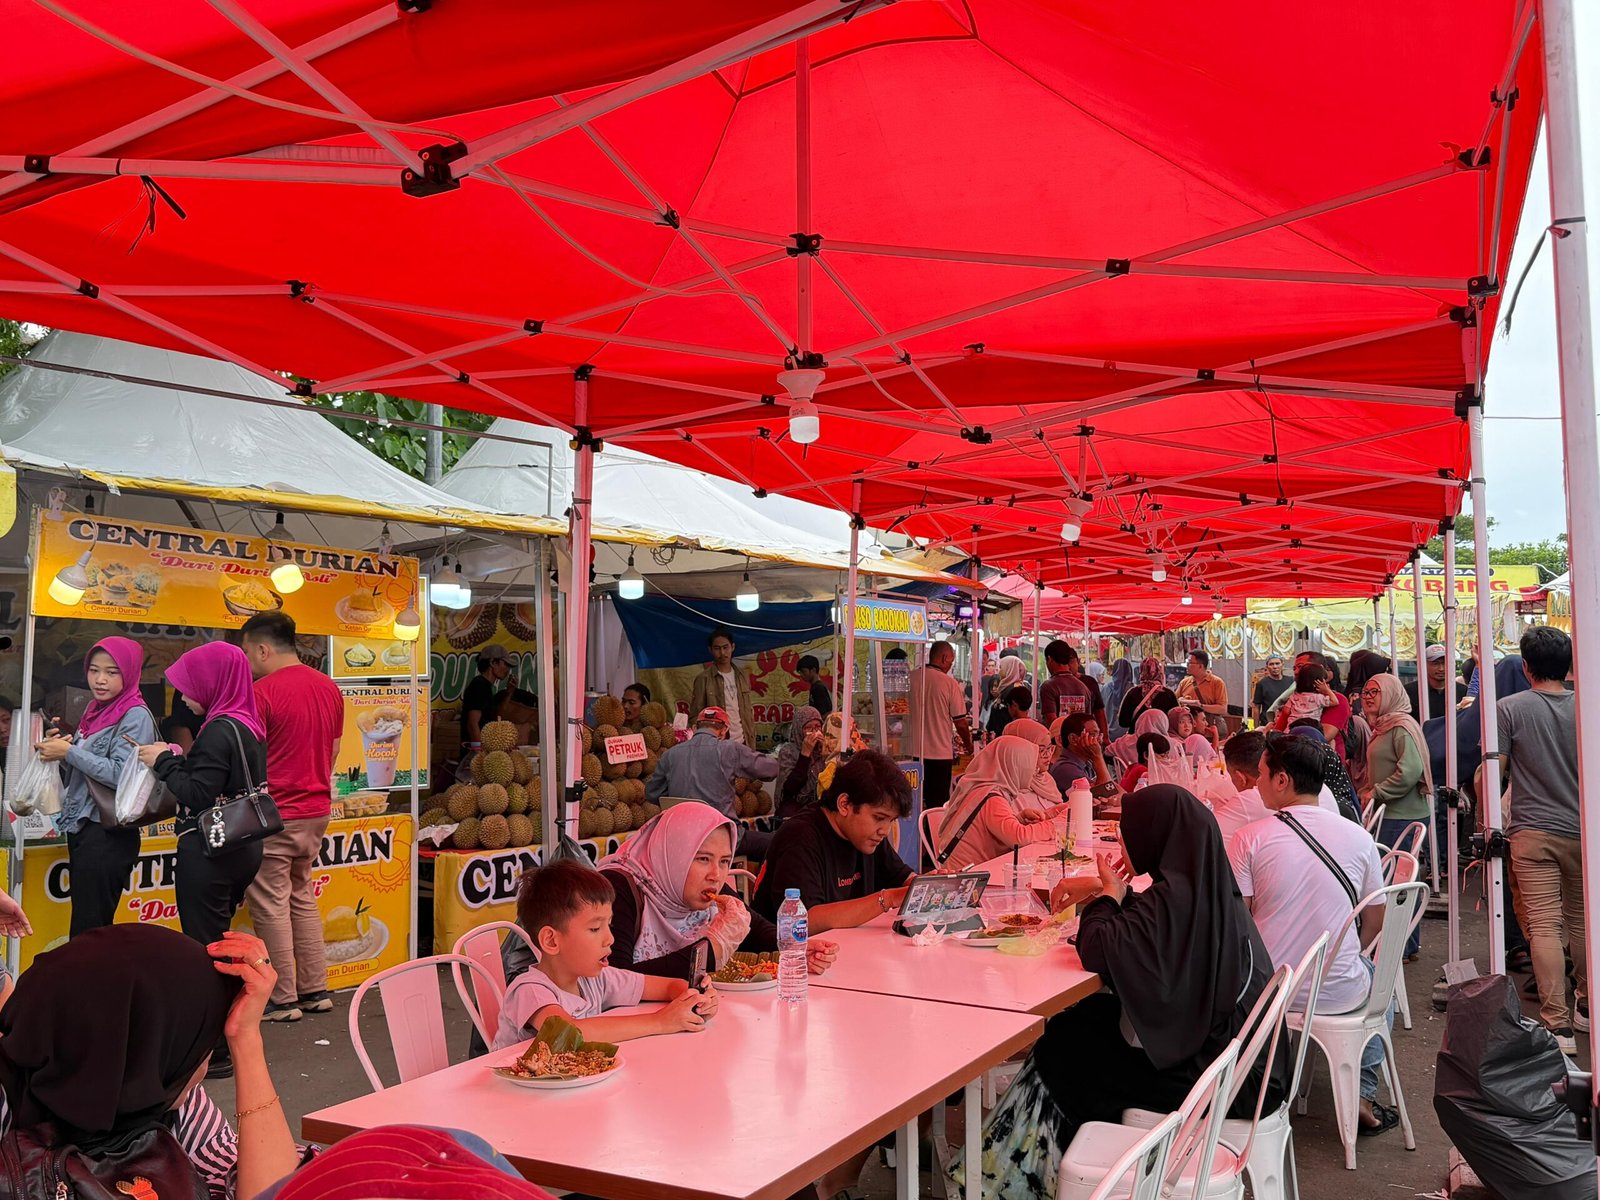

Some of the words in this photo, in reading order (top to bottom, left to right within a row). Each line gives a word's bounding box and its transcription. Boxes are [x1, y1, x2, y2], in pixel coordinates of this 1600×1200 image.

[68, 519, 257, 561] CENTRAL
[1398, 567, 1477, 575] MARTABA
[118, 607, 142, 615] Durian
[873, 607, 910, 633] BAROKAH
[340, 688, 384, 696] CENTRAL
[367, 748, 397, 758] Kocok
[608, 742, 643, 756] PETRUK
[312, 830, 392, 868] RIAN
[341, 962, 370, 974] Durian
